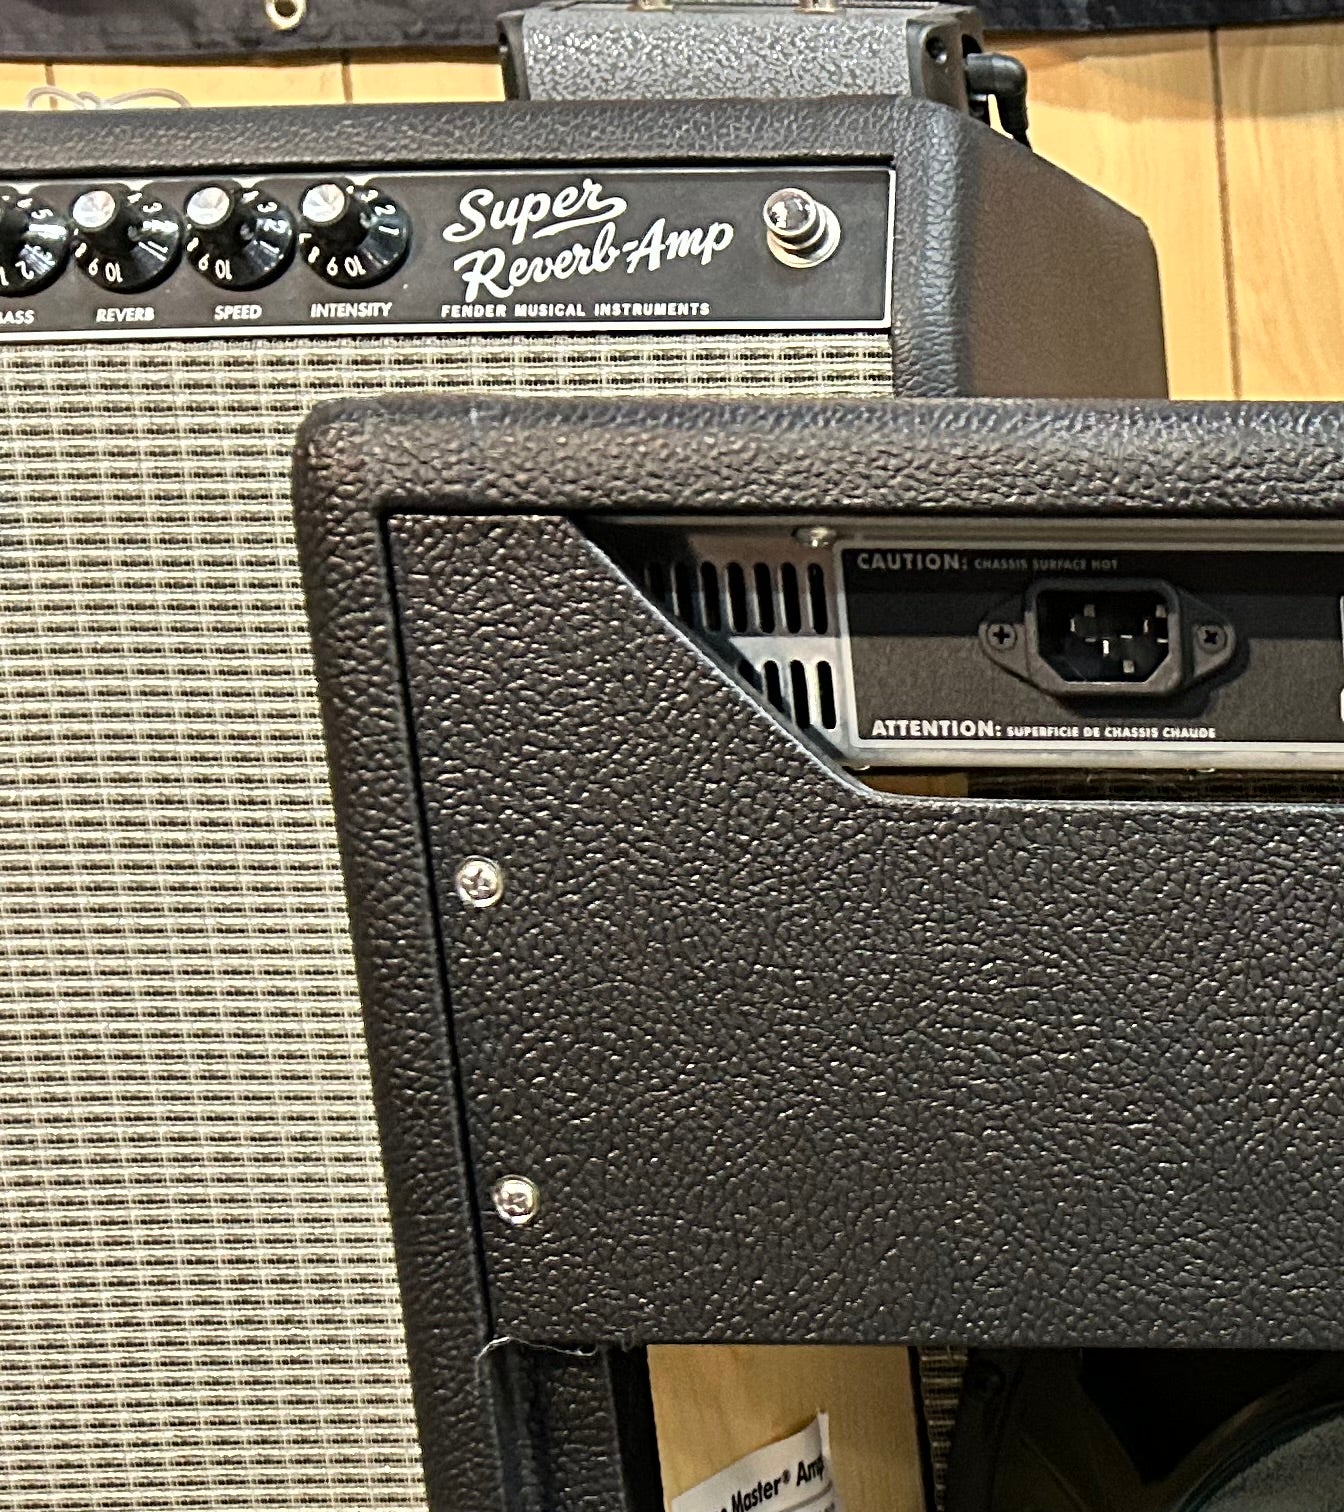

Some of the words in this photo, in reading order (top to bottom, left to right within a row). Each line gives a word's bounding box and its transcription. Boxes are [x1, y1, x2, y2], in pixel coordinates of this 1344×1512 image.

[442, 178, 628, 245] Super
[453, 217, 735, 303] Reverb-Amp
[96, 307, 155, 322] REVERB
[213, 304, 263, 320] SPEED
[310, 302, 393, 317] INTENSITY
[441, 304, 507, 318] FENDER
[514, 303, 586, 317] MUSICAL
[594, 302, 710, 316] INSTRUMENTS
[857, 553, 968, 570] CAUTION:
[974, 559, 1028, 570] CHASSIS
[1032, 559, 1088, 570] SURFACE
[1092, 559, 1119, 570] HOT
[872, 720, 1002, 738] ATTENTION:
[1006, 727, 1079, 738] SUPERFICIE
[1083, 727, 1101, 738] DE
[1104, 727, 1159, 738] CHASSIS
[1163, 727, 1216, 739] CHAUDE
